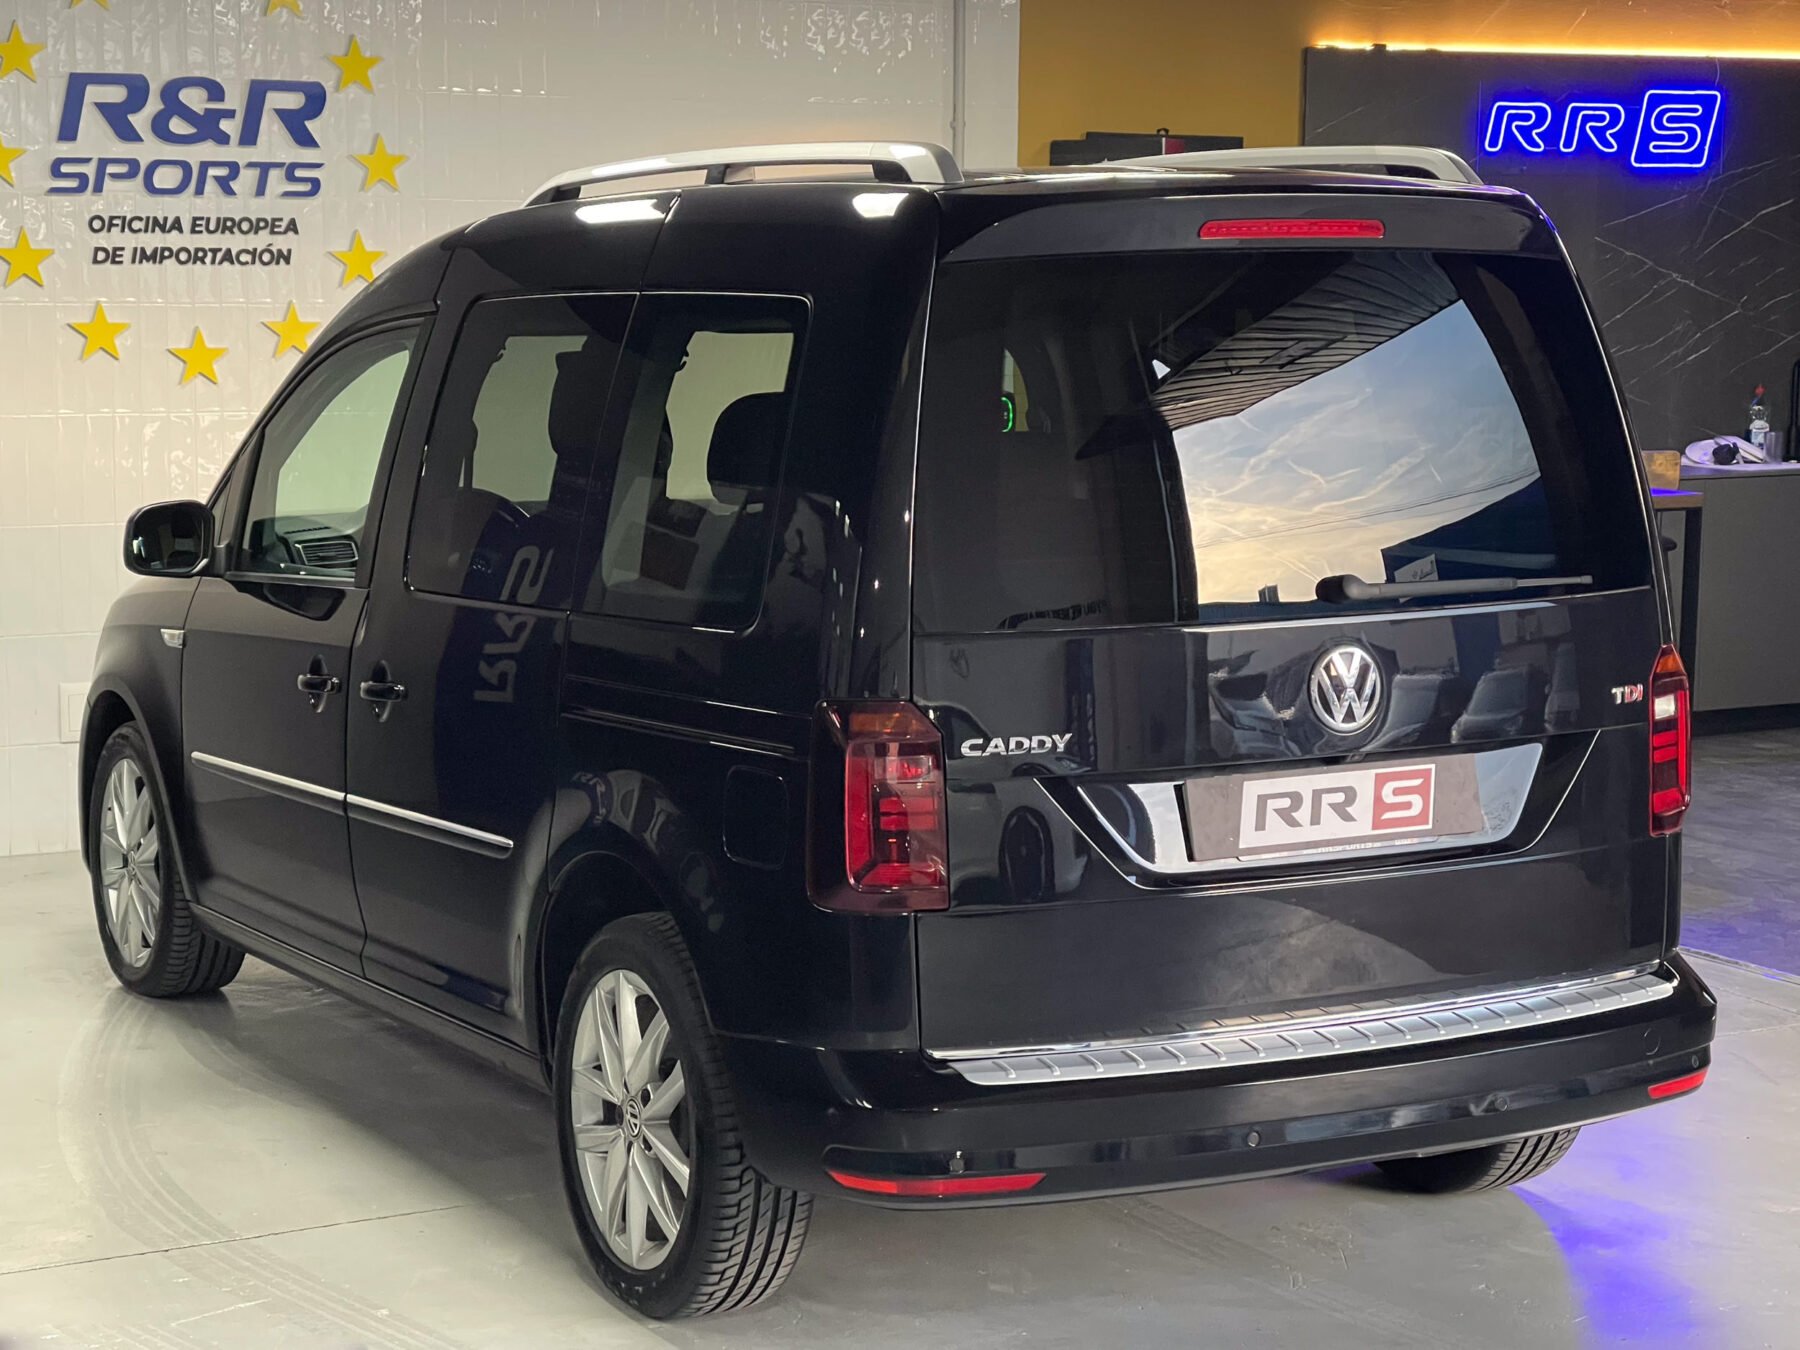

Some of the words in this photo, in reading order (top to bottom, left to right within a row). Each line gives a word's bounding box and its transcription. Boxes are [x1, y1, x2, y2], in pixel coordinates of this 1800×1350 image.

[57, 72, 326, 148] R&R
[1485, 97, 1706, 155] RRS
[45, 157, 325, 197] SPORTS
[88, 215, 184, 234] OFICINA
[190, 216, 299, 235] EUROPEA
[92, 246, 124, 264] DE
[131, 244, 292, 265] IMPORTACIÓN
[1611, 683, 1644, 705] TDI
[960, 733, 1073, 757] CADDY
[1254, 777, 1425, 832] RRS
